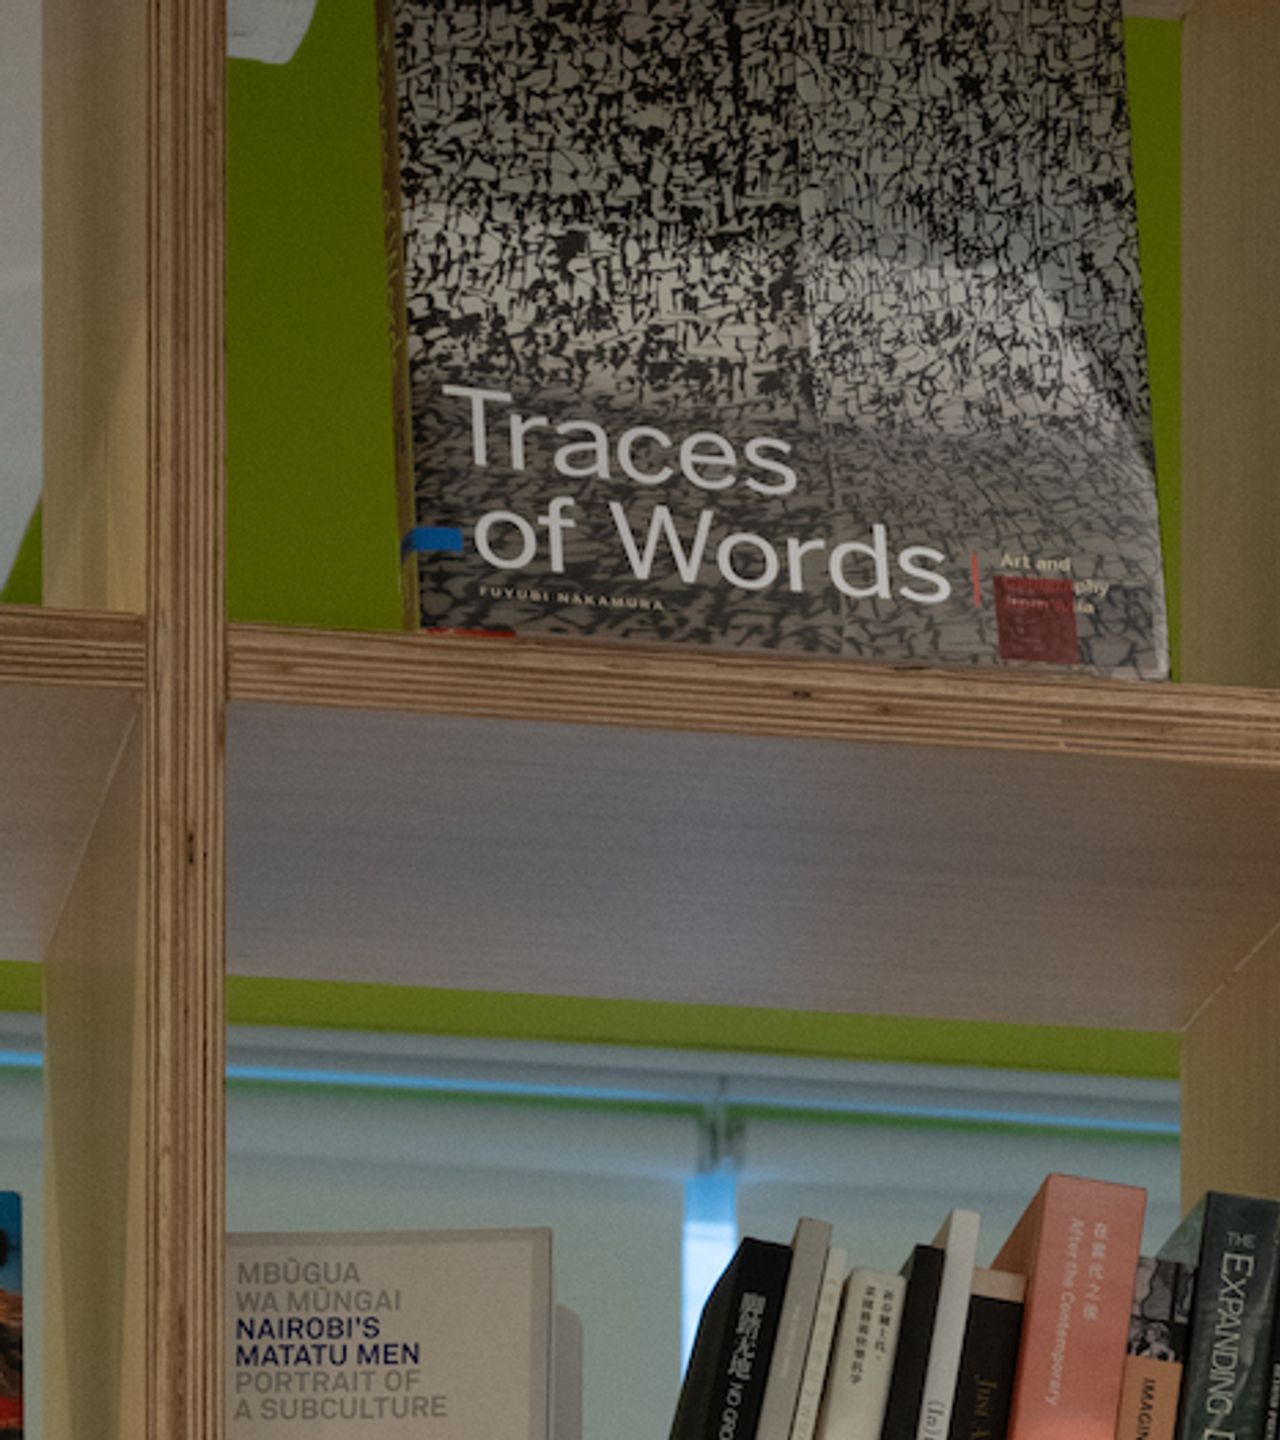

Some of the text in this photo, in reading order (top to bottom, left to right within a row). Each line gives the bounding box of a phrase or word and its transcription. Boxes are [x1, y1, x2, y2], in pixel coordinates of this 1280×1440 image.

[442, 383, 798, 497] Traces
[473, 496, 577, 574] of
[608, 499, 953, 605] Words
[478, 584, 666, 612] FUYUBI NAKAMURA
[1066, 1216, 1086, 1259] After
[1227, 1231, 1257, 1250] THE
[236, 1289, 279, 1313] WA
[236, 1316, 381, 1341] NAIROBI'S
[1206, 1252, 1256, 1416] EXPANDING
[235, 1342, 421, 1367] MATATU MEN
[1043, 1290, 1076, 1408] Contemporary
[235, 1368, 421, 1394] PORTRAIT OF
[726, 1380, 744, 1408] NO
[233, 1396, 449, 1421] A SUBCULTURE
